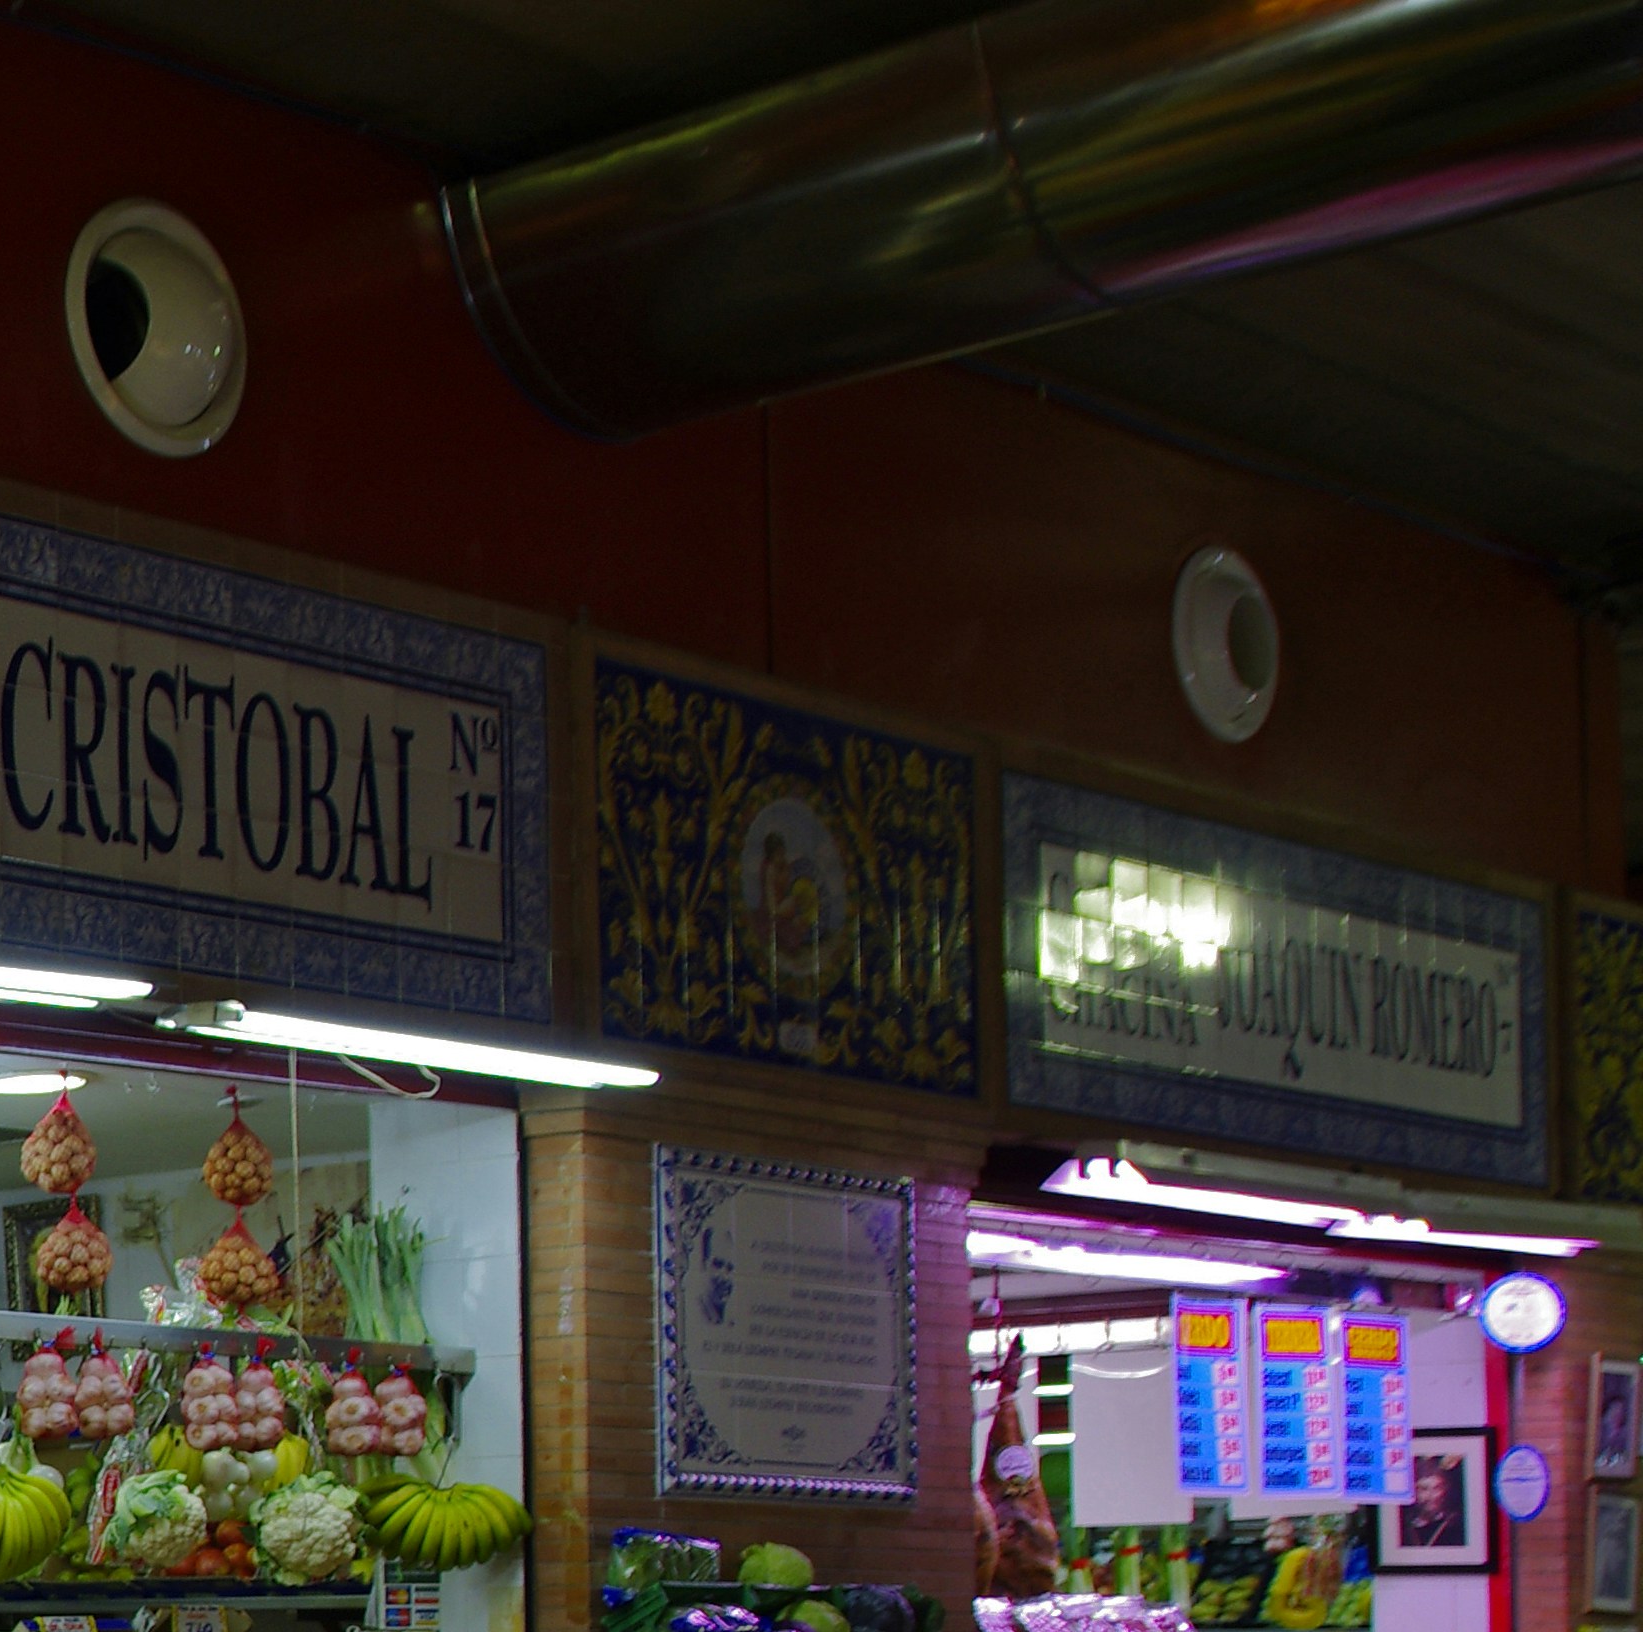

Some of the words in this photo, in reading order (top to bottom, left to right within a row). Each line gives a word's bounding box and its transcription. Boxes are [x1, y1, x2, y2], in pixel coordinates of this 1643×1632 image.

[1, 635, 433, 911] CRISTOBAL
[454, 789, 498, 852] 17
[1371, 953, 1497, 1079] ROMERO
